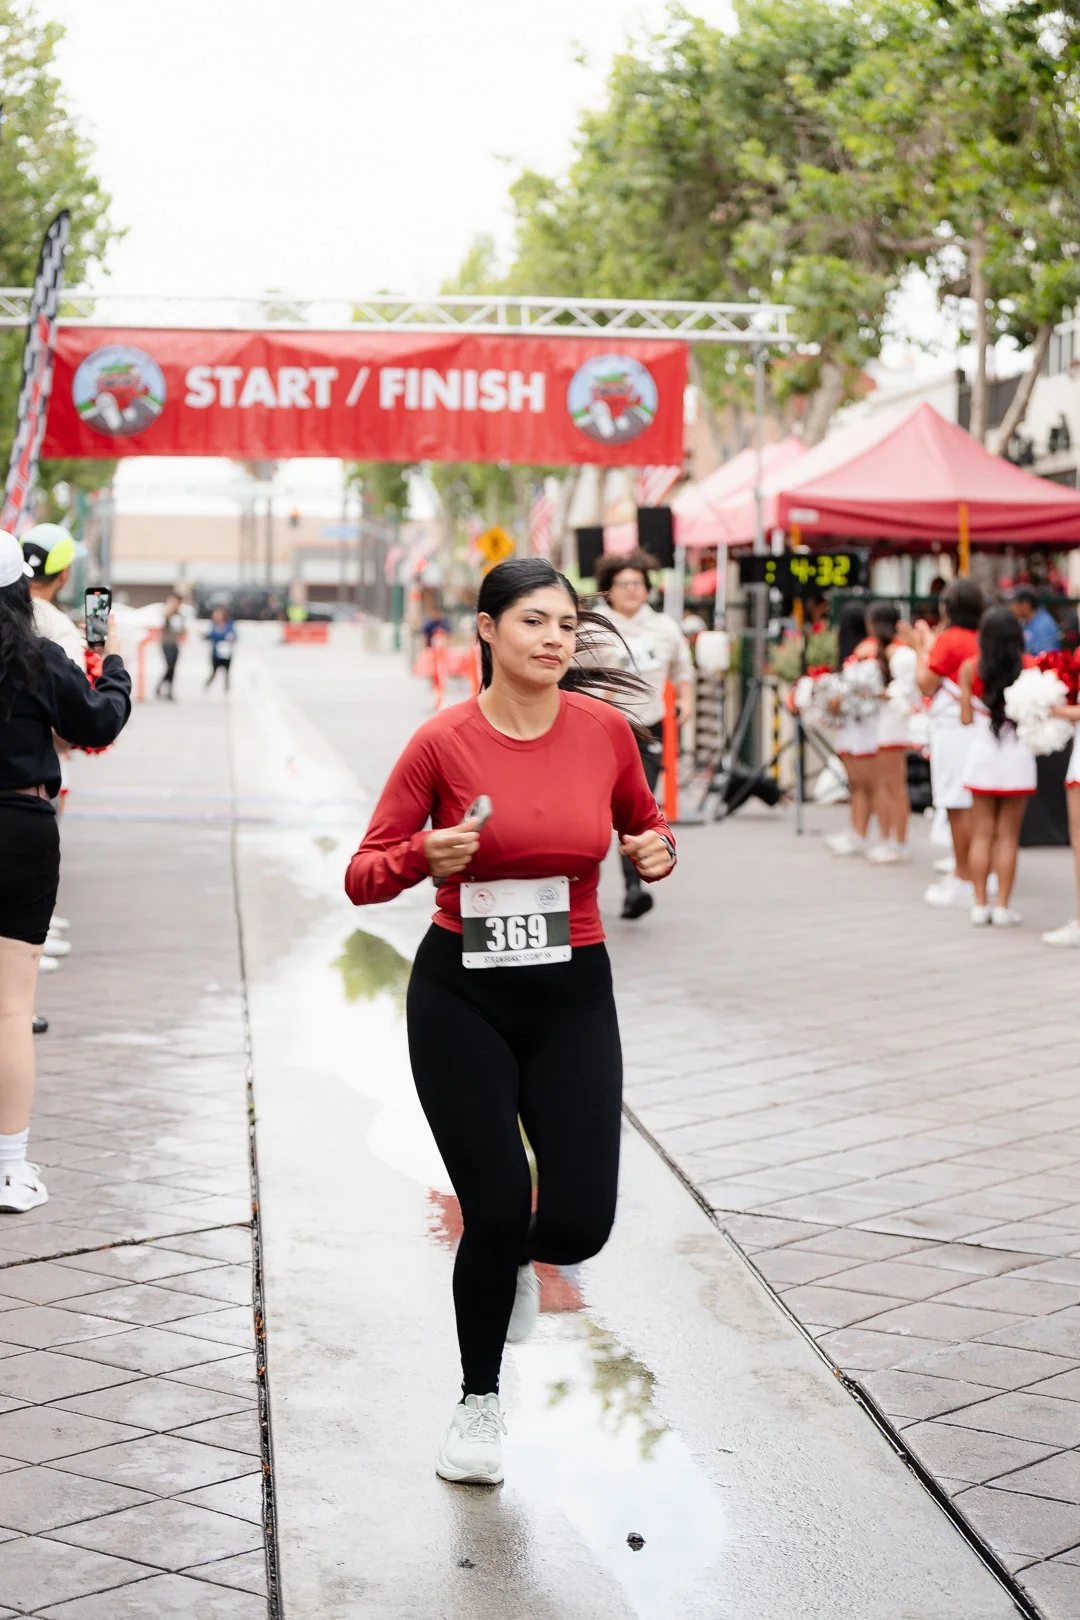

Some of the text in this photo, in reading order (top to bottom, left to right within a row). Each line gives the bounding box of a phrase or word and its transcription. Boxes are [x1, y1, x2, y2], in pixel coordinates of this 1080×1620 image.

[185, 366, 339, 409] START
[379, 367, 546, 414] FINISH
[485, 914, 548, 952] 369
